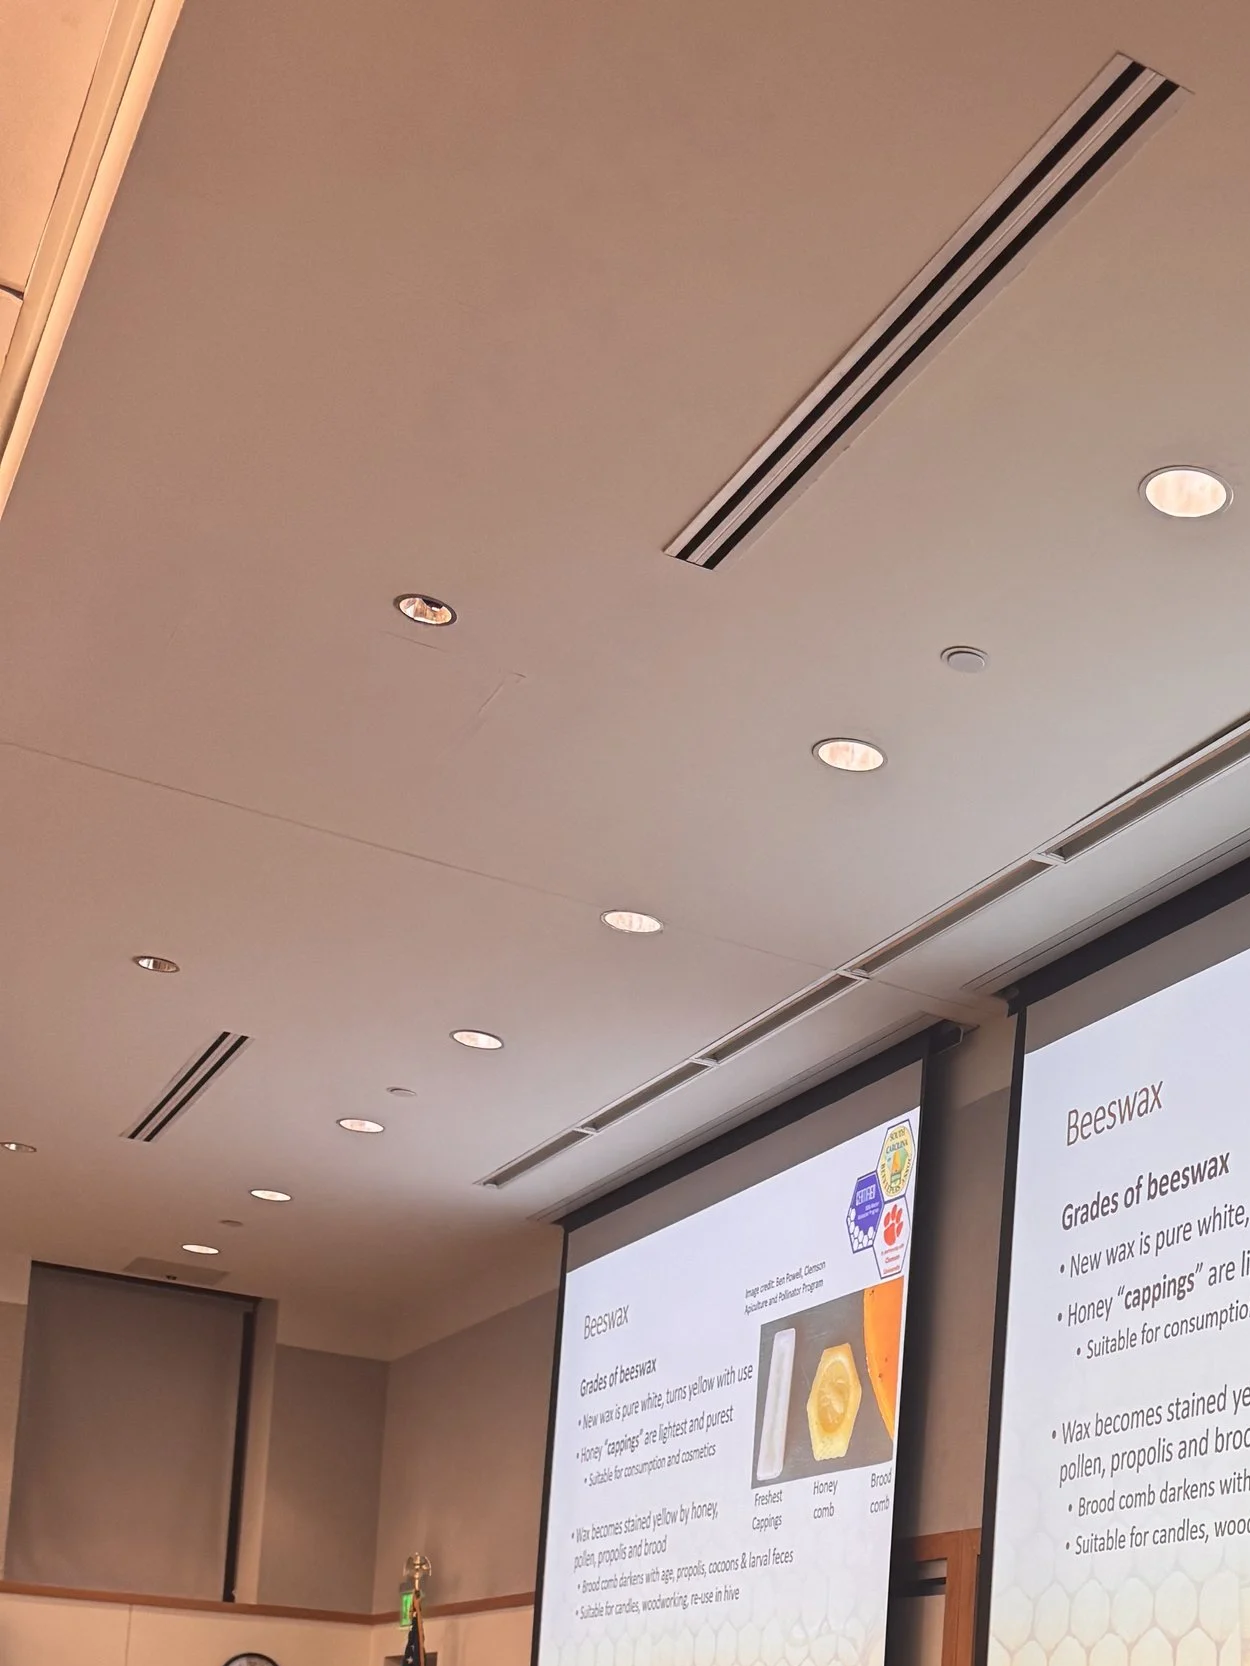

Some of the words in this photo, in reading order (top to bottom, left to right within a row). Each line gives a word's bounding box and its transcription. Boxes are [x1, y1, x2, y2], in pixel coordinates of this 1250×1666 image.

[1067, 1081, 1163, 1146] Beeswax
[1062, 1191, 1119, 1230] Grades
[1124, 1175, 1143, 1208] of
[1147, 1152, 1230, 1200] beeswax
[1070, 1251, 1102, 1278] New
[1106, 1240, 1135, 1266] wax
[1139, 1231, 1150, 1255] is
[1155, 1222, 1192, 1257] pure
[1197, 1204, 1249, 1236] white,
[1068, 1297, 1113, 1326] Honey
[1208, 1261, 1235, 1286] are
[584, 1305, 629, 1340] Beeswax
[1087, 1327, 1137, 1359] Suitable
[1141, 1322, 1161, 1345] for
[580, 1373, 607, 1397] Grades
[609, 1366, 619, 1387] of
[619, 1359, 656, 1383] beeswax
[1062, 1420, 1091, 1444] Wax
[1095, 1405, 1162, 1437] becomes
[1167, 1384, 1227, 1422] stained
[1060, 1453, 1105, 1488] pollen,
[1110, 1437, 1173, 1478] propolis
[1178, 1428, 1209, 1460] and
[755, 1490, 783, 1506] Freshest
[813, 1480, 838, 1495] Honey
[870, 1495, 890, 1513] comb
[1078, 1489, 1115, 1517] Brood
[1119, 1484, 1155, 1510] comb
[1159, 1478, 1215, 1504] darkens
[1219, 1468, 1250, 1495] with
[752, 1514, 782, 1532] Cappings
[813, 1501, 835, 1519] comb
[1075, 1528, 1126, 1555] Suitable
[1130, 1525, 1149, 1548] for
[1152, 1518, 1209, 1545] candles,
